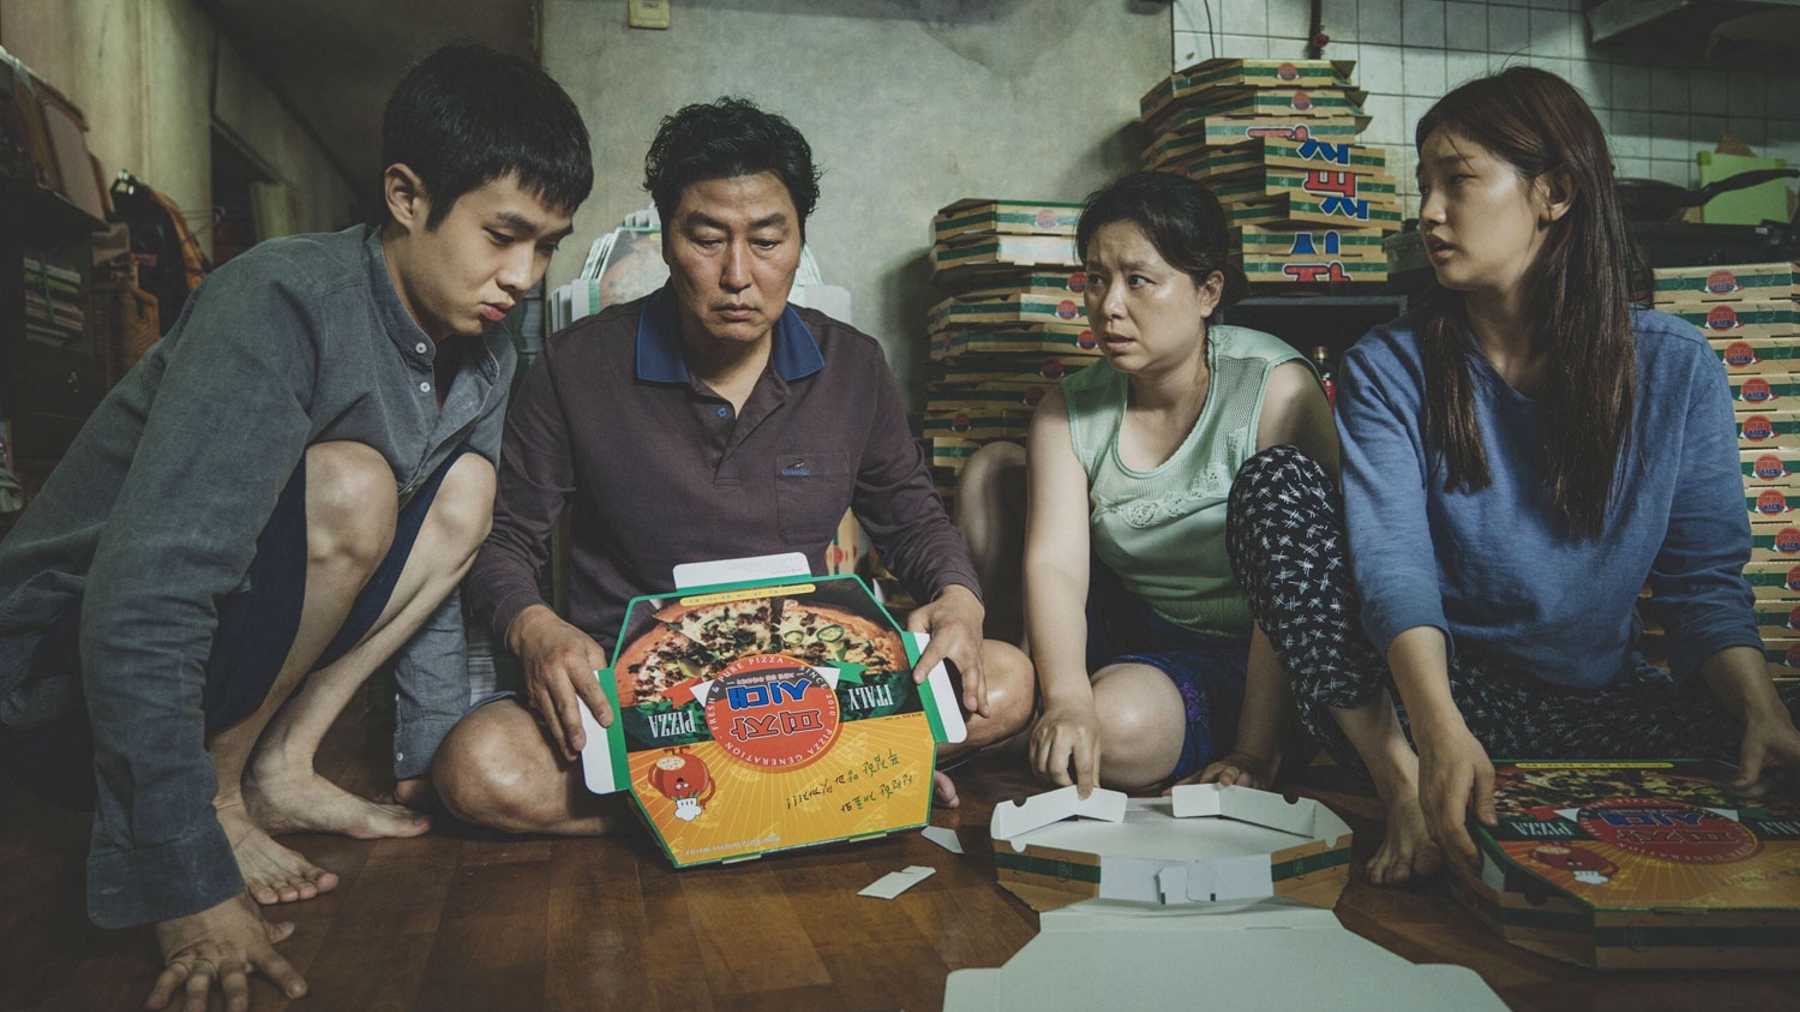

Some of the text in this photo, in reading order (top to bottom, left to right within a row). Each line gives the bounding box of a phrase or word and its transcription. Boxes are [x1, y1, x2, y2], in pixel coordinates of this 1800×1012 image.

[747, 656, 785, 666] PIZZA
[726, 678, 812, 711] 시대
[848, 683, 895, 711] ITALY
[648, 709, 697, 739] PIZZA
[730, 708, 824, 743] 피자
[724, 728, 834, 766] PIZZA GENERATION
[1511, 821, 1574, 837] PIZZA
